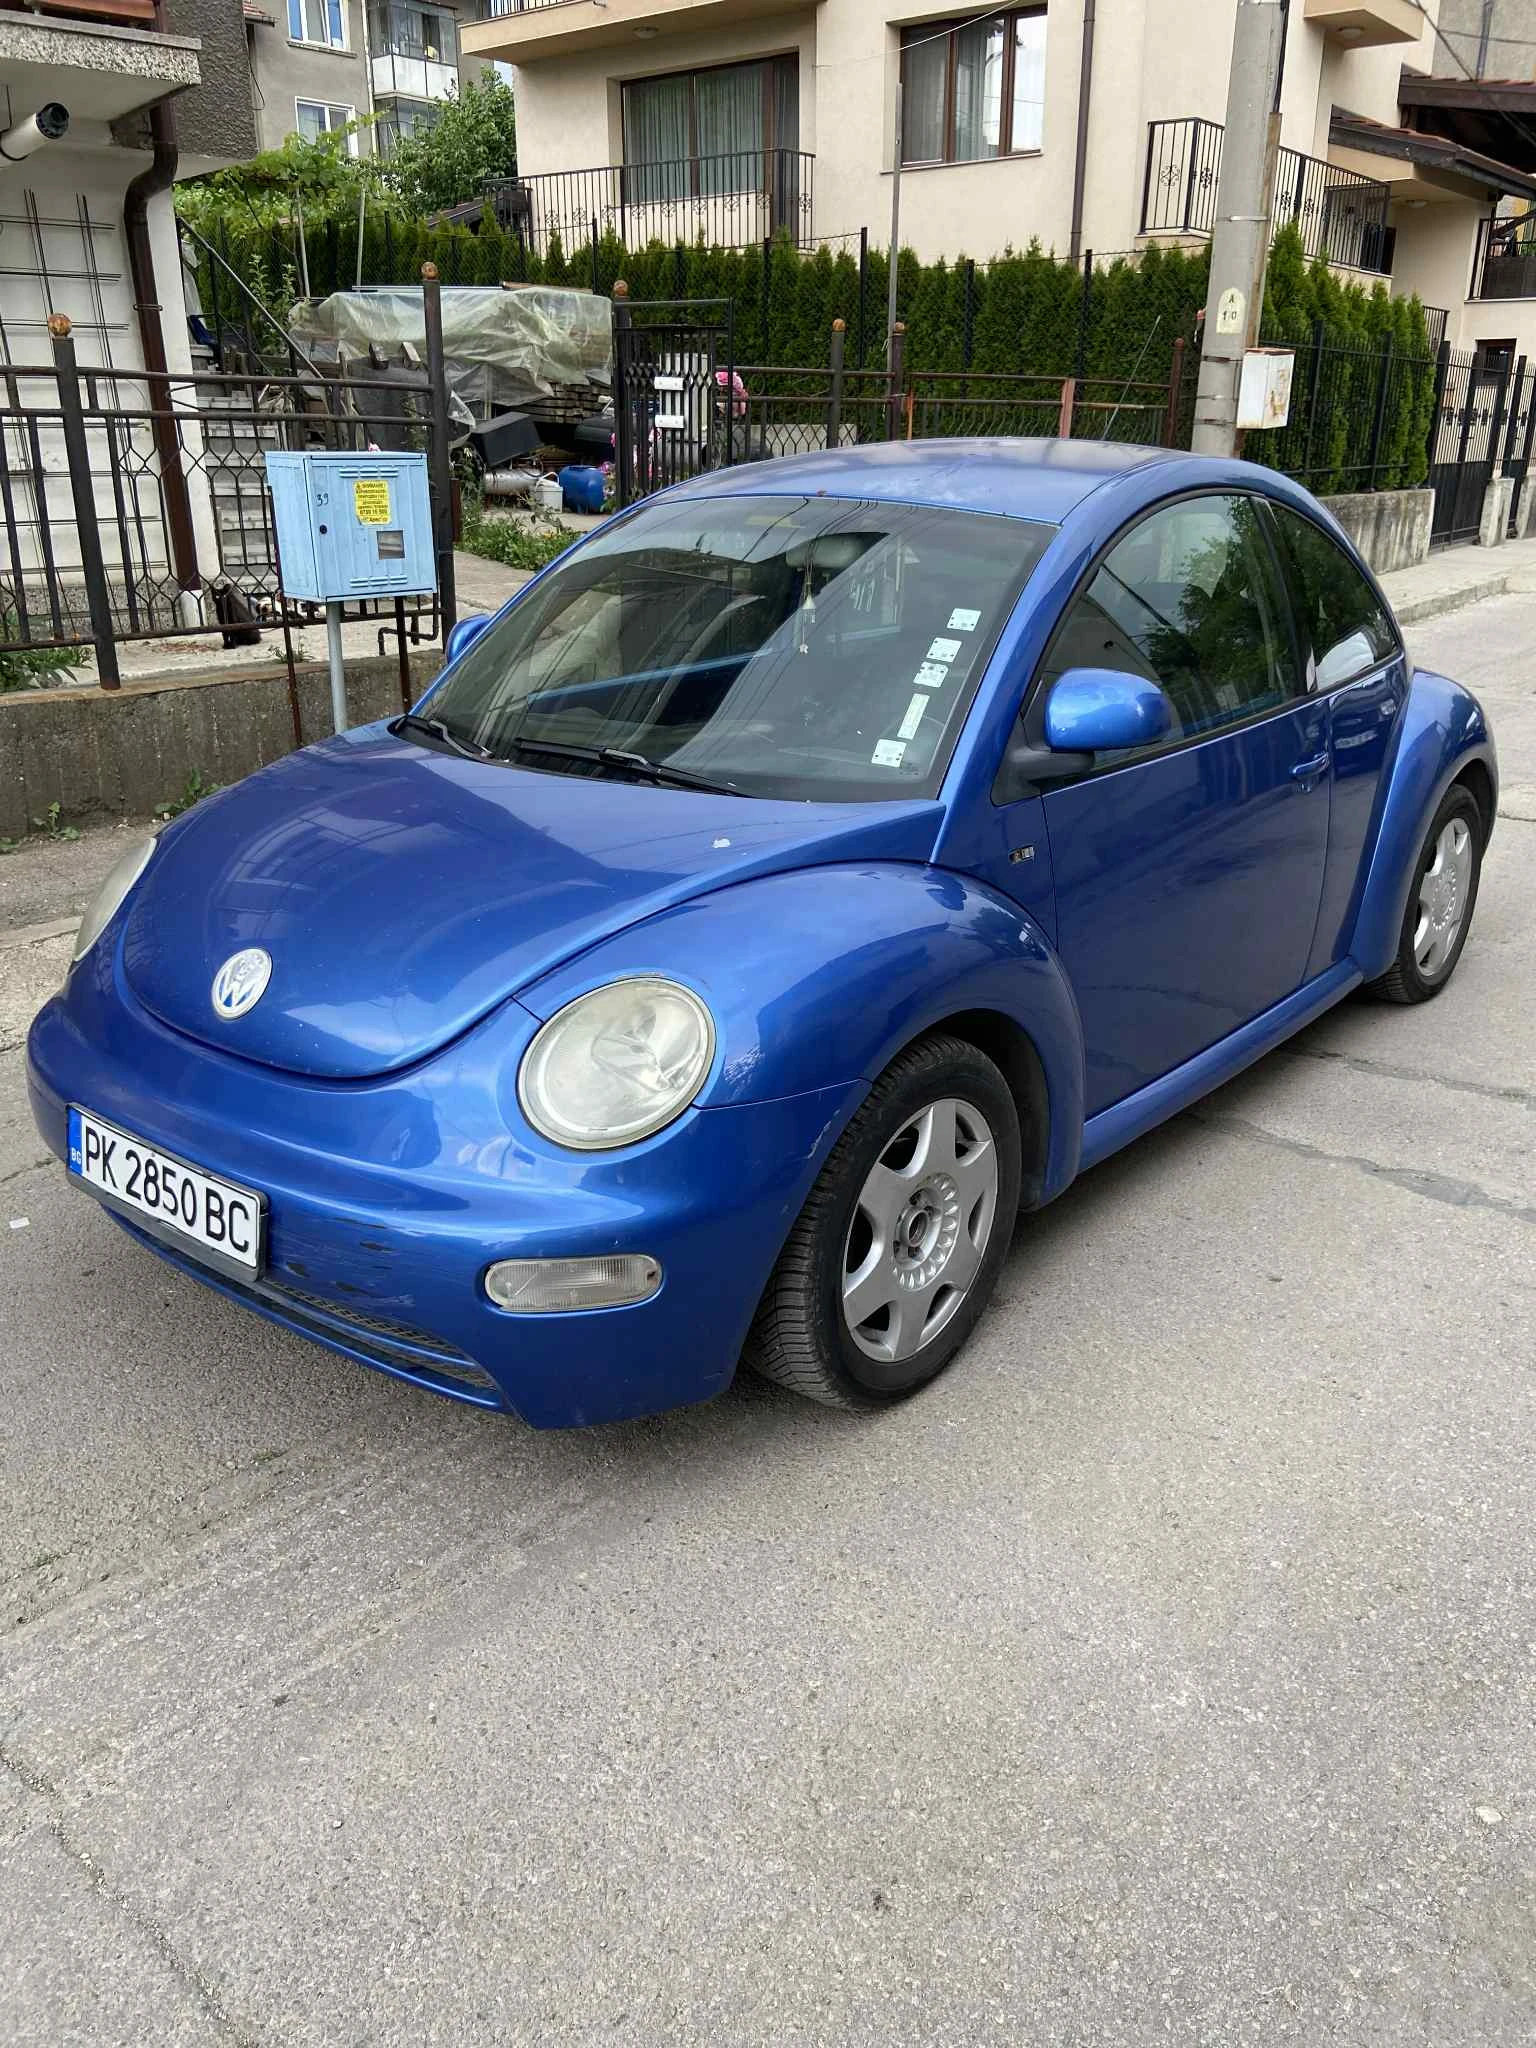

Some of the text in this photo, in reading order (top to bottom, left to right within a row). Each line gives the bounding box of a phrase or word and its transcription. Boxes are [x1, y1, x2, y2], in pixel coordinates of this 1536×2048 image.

[315, 493, 329, 507] 39
[71, 1147, 82, 1164] BG
[85, 1126, 250, 1253] PK 2850 BC
